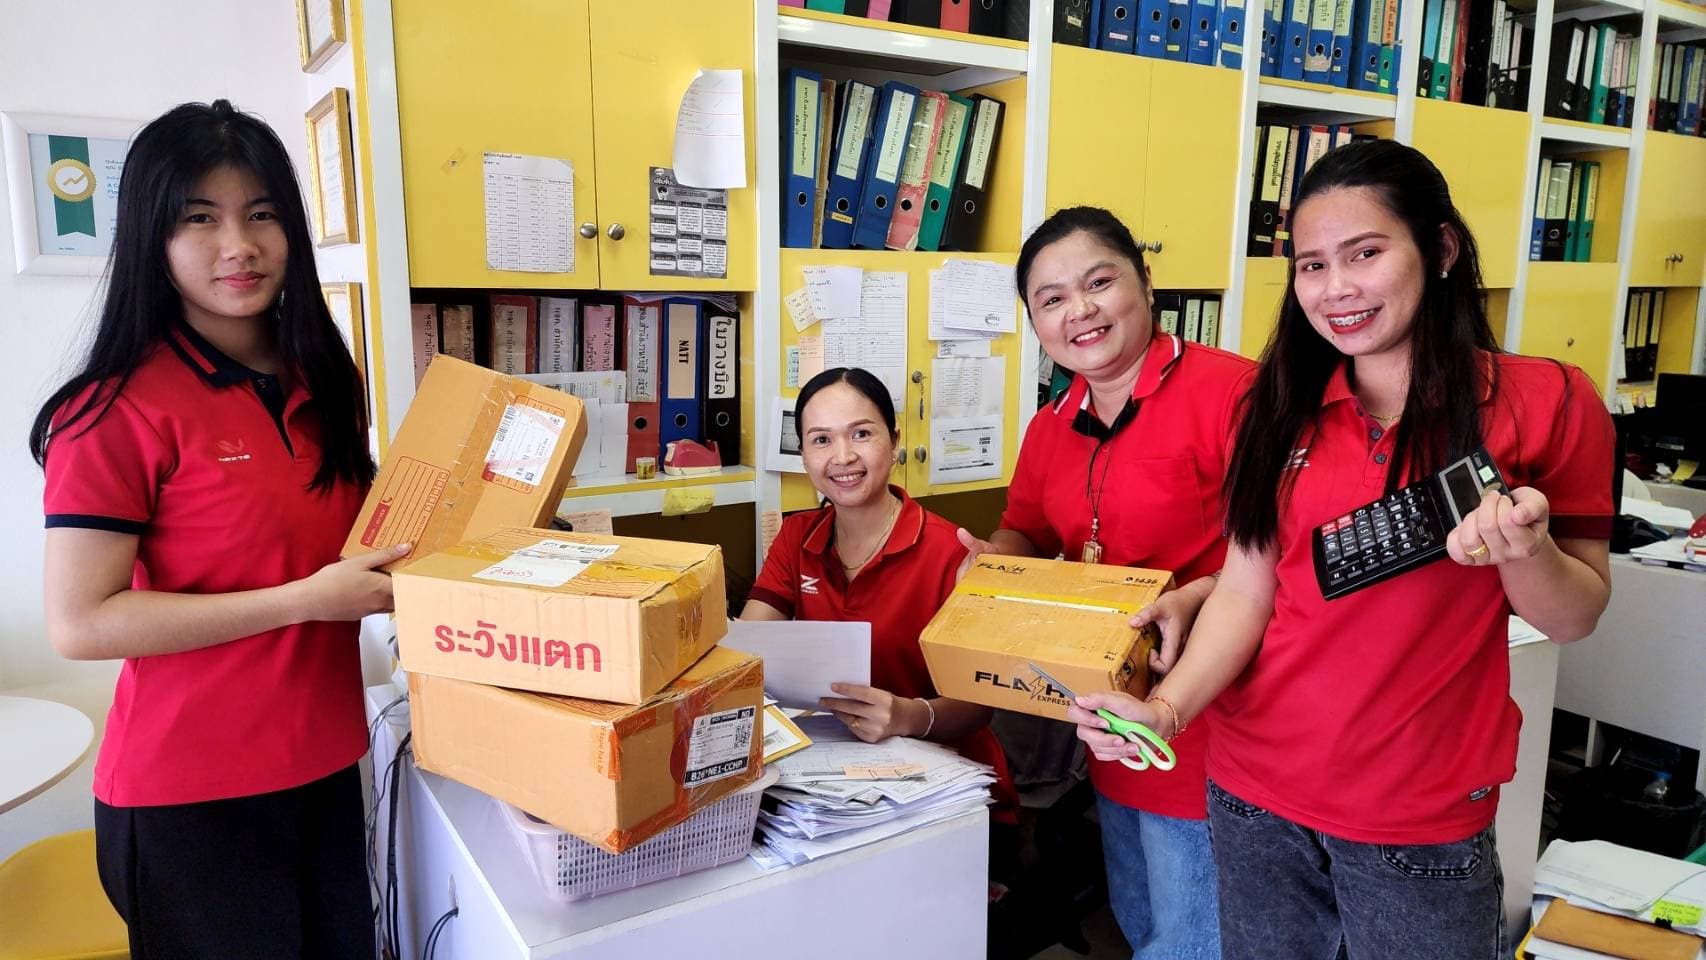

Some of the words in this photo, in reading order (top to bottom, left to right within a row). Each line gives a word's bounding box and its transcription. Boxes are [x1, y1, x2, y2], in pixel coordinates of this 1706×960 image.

[678, 340, 689, 364] NATT
[713, 318, 732, 395] ใบวางบิล
[434, 620, 601, 672] ระวังแตก
[1037, 694, 1072, 707] EXPRESS
